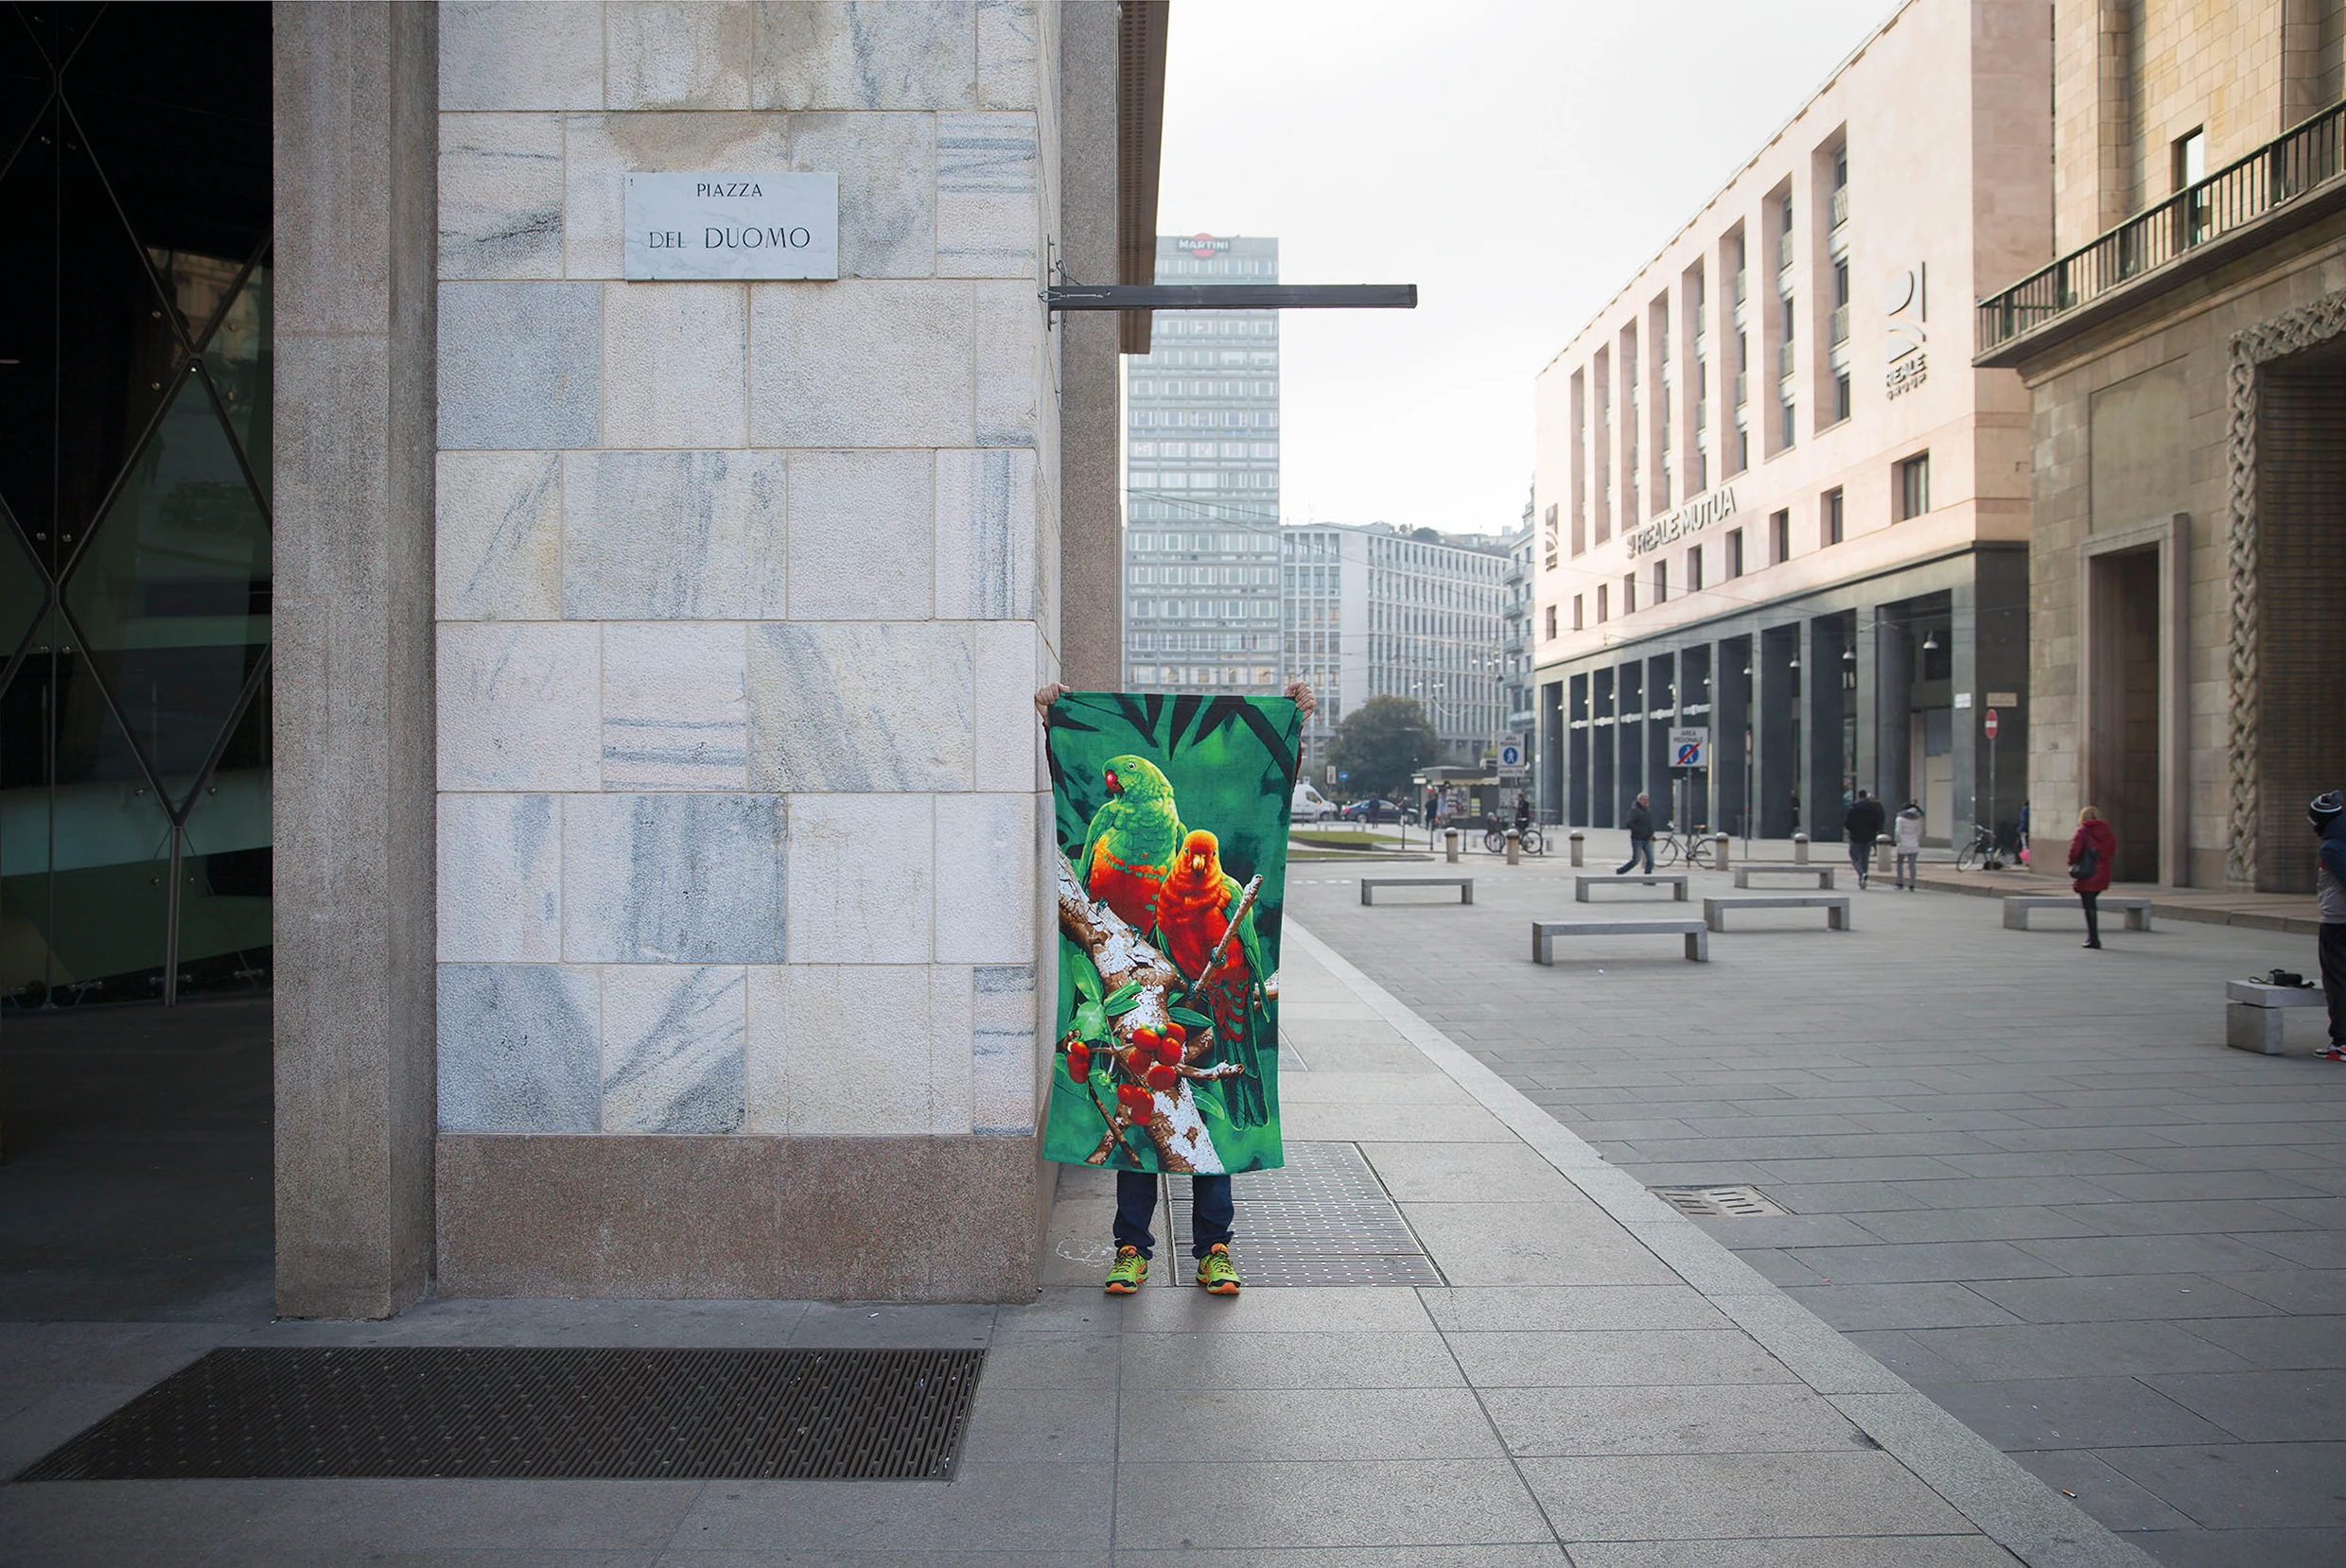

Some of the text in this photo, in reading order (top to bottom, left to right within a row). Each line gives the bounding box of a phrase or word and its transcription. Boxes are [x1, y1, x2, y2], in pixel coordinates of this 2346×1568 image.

[696, 183, 763, 198] PIAZZA
[649, 227, 811, 249] DEL DUOMO
[1179, 238, 1229, 250] MARTINI
[1885, 354, 1927, 387] REALE
[1886, 373, 1927, 400] GROUP
[1637, 485, 1737, 555] REALE MUTUA
